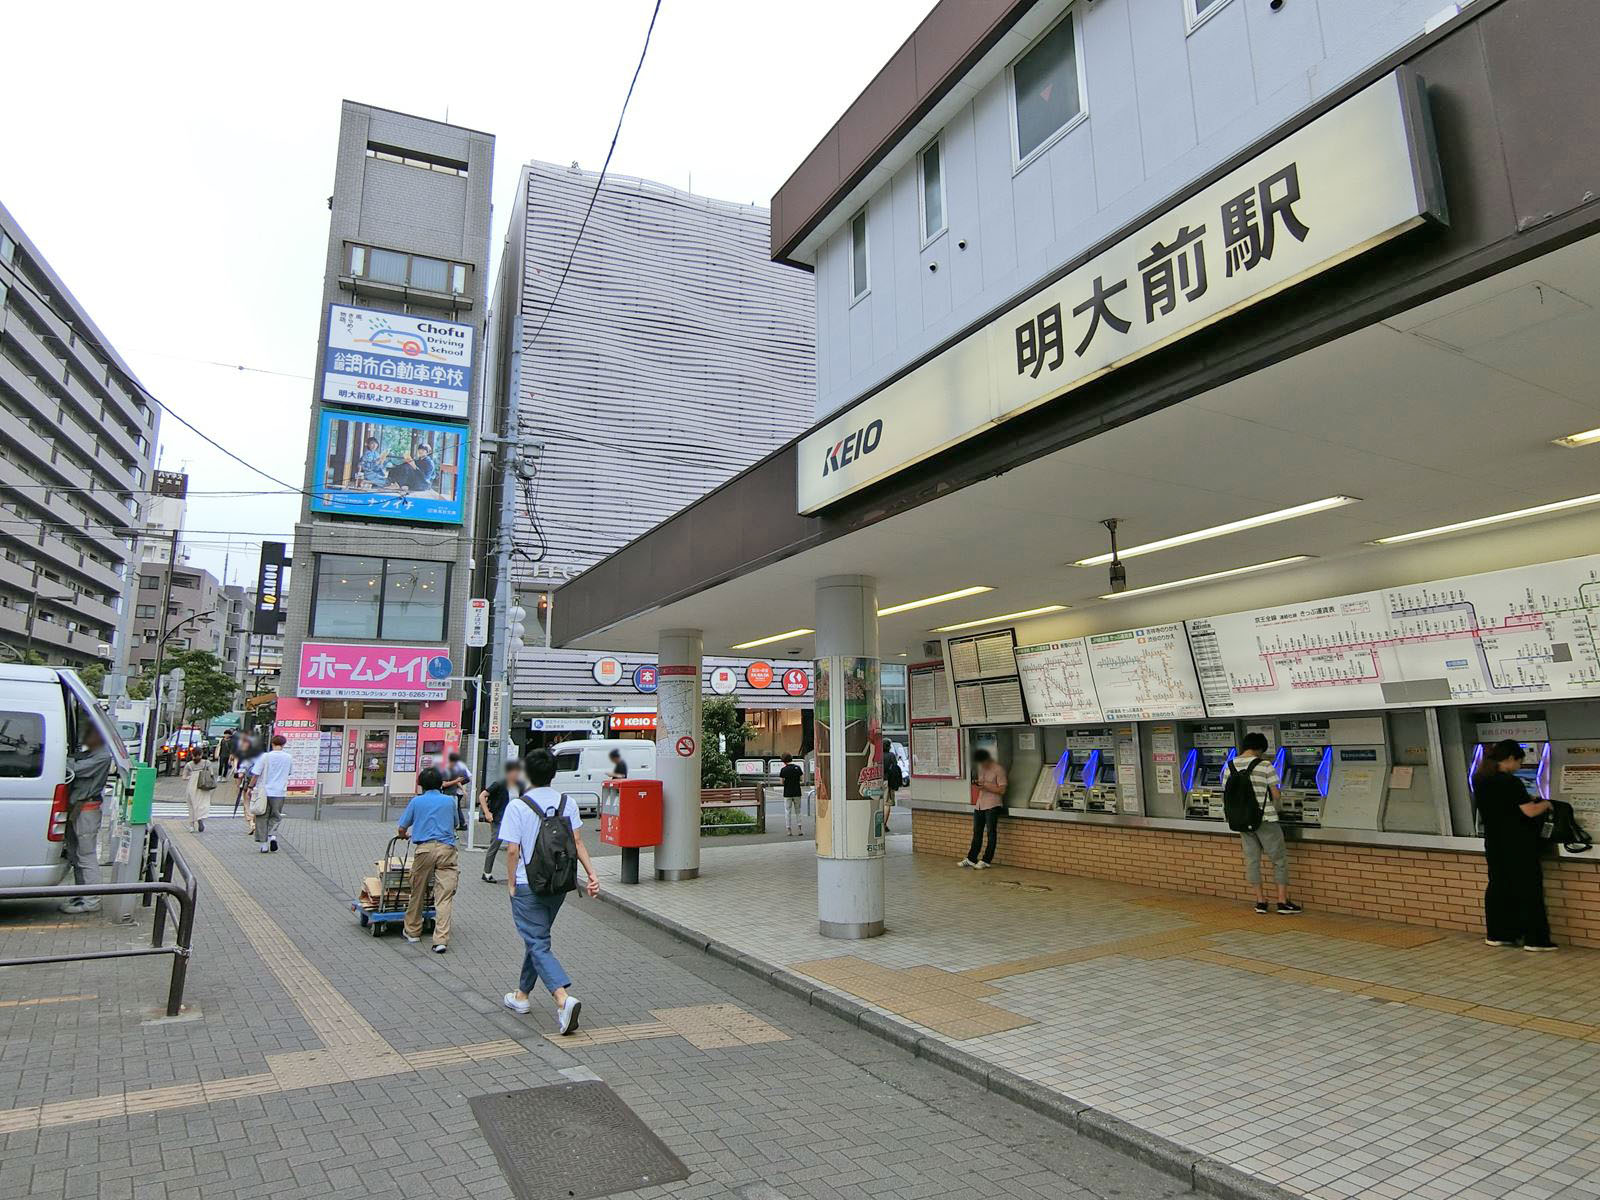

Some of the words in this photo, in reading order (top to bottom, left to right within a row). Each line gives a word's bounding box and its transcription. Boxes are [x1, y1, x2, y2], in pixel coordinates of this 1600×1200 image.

[1015, 161, 1310, 380] 明大前駅
[417, 323, 465, 338] Chofu
[427, 337, 464, 349] Driving
[431, 346, 463, 356] School
[344, 354, 463, 387] 調布自動車学校
[821, 418, 883, 477] KEIO
[368, 498, 414, 510] ナツイチ
[1300, 606, 1335, 617] きっぷ運賃表
[641, 671, 654, 682] 本
[623, 717, 651, 726] KEIO
